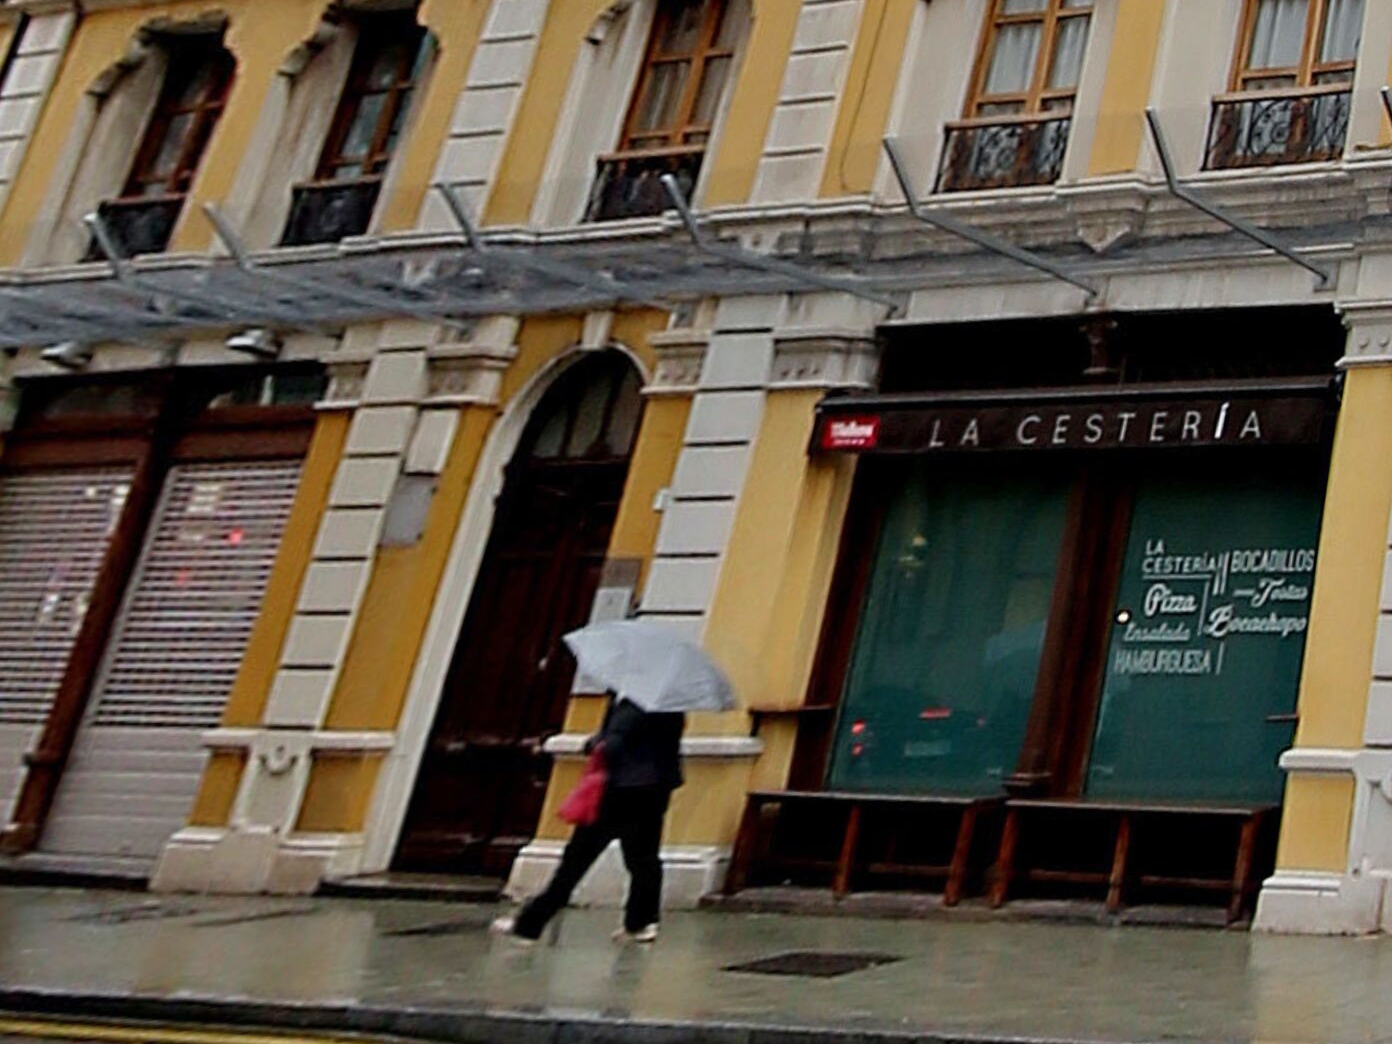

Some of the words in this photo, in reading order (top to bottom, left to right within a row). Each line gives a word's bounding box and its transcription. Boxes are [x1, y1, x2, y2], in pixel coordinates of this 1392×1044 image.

[930, 419, 979, 447] LA
[1017, 402, 1261, 444] CESTERÍA
[1146, 540, 1165, 555] LA
[1142, 553, 1216, 573] CESTERÍA
[1230, 550, 1315, 574] BOCADILLOS
[1144, 582, 1199, 617] Pizza
[1123, 621, 1191, 642] Ensalada
[1113, 648, 1211, 674] HAMBURGUESA
